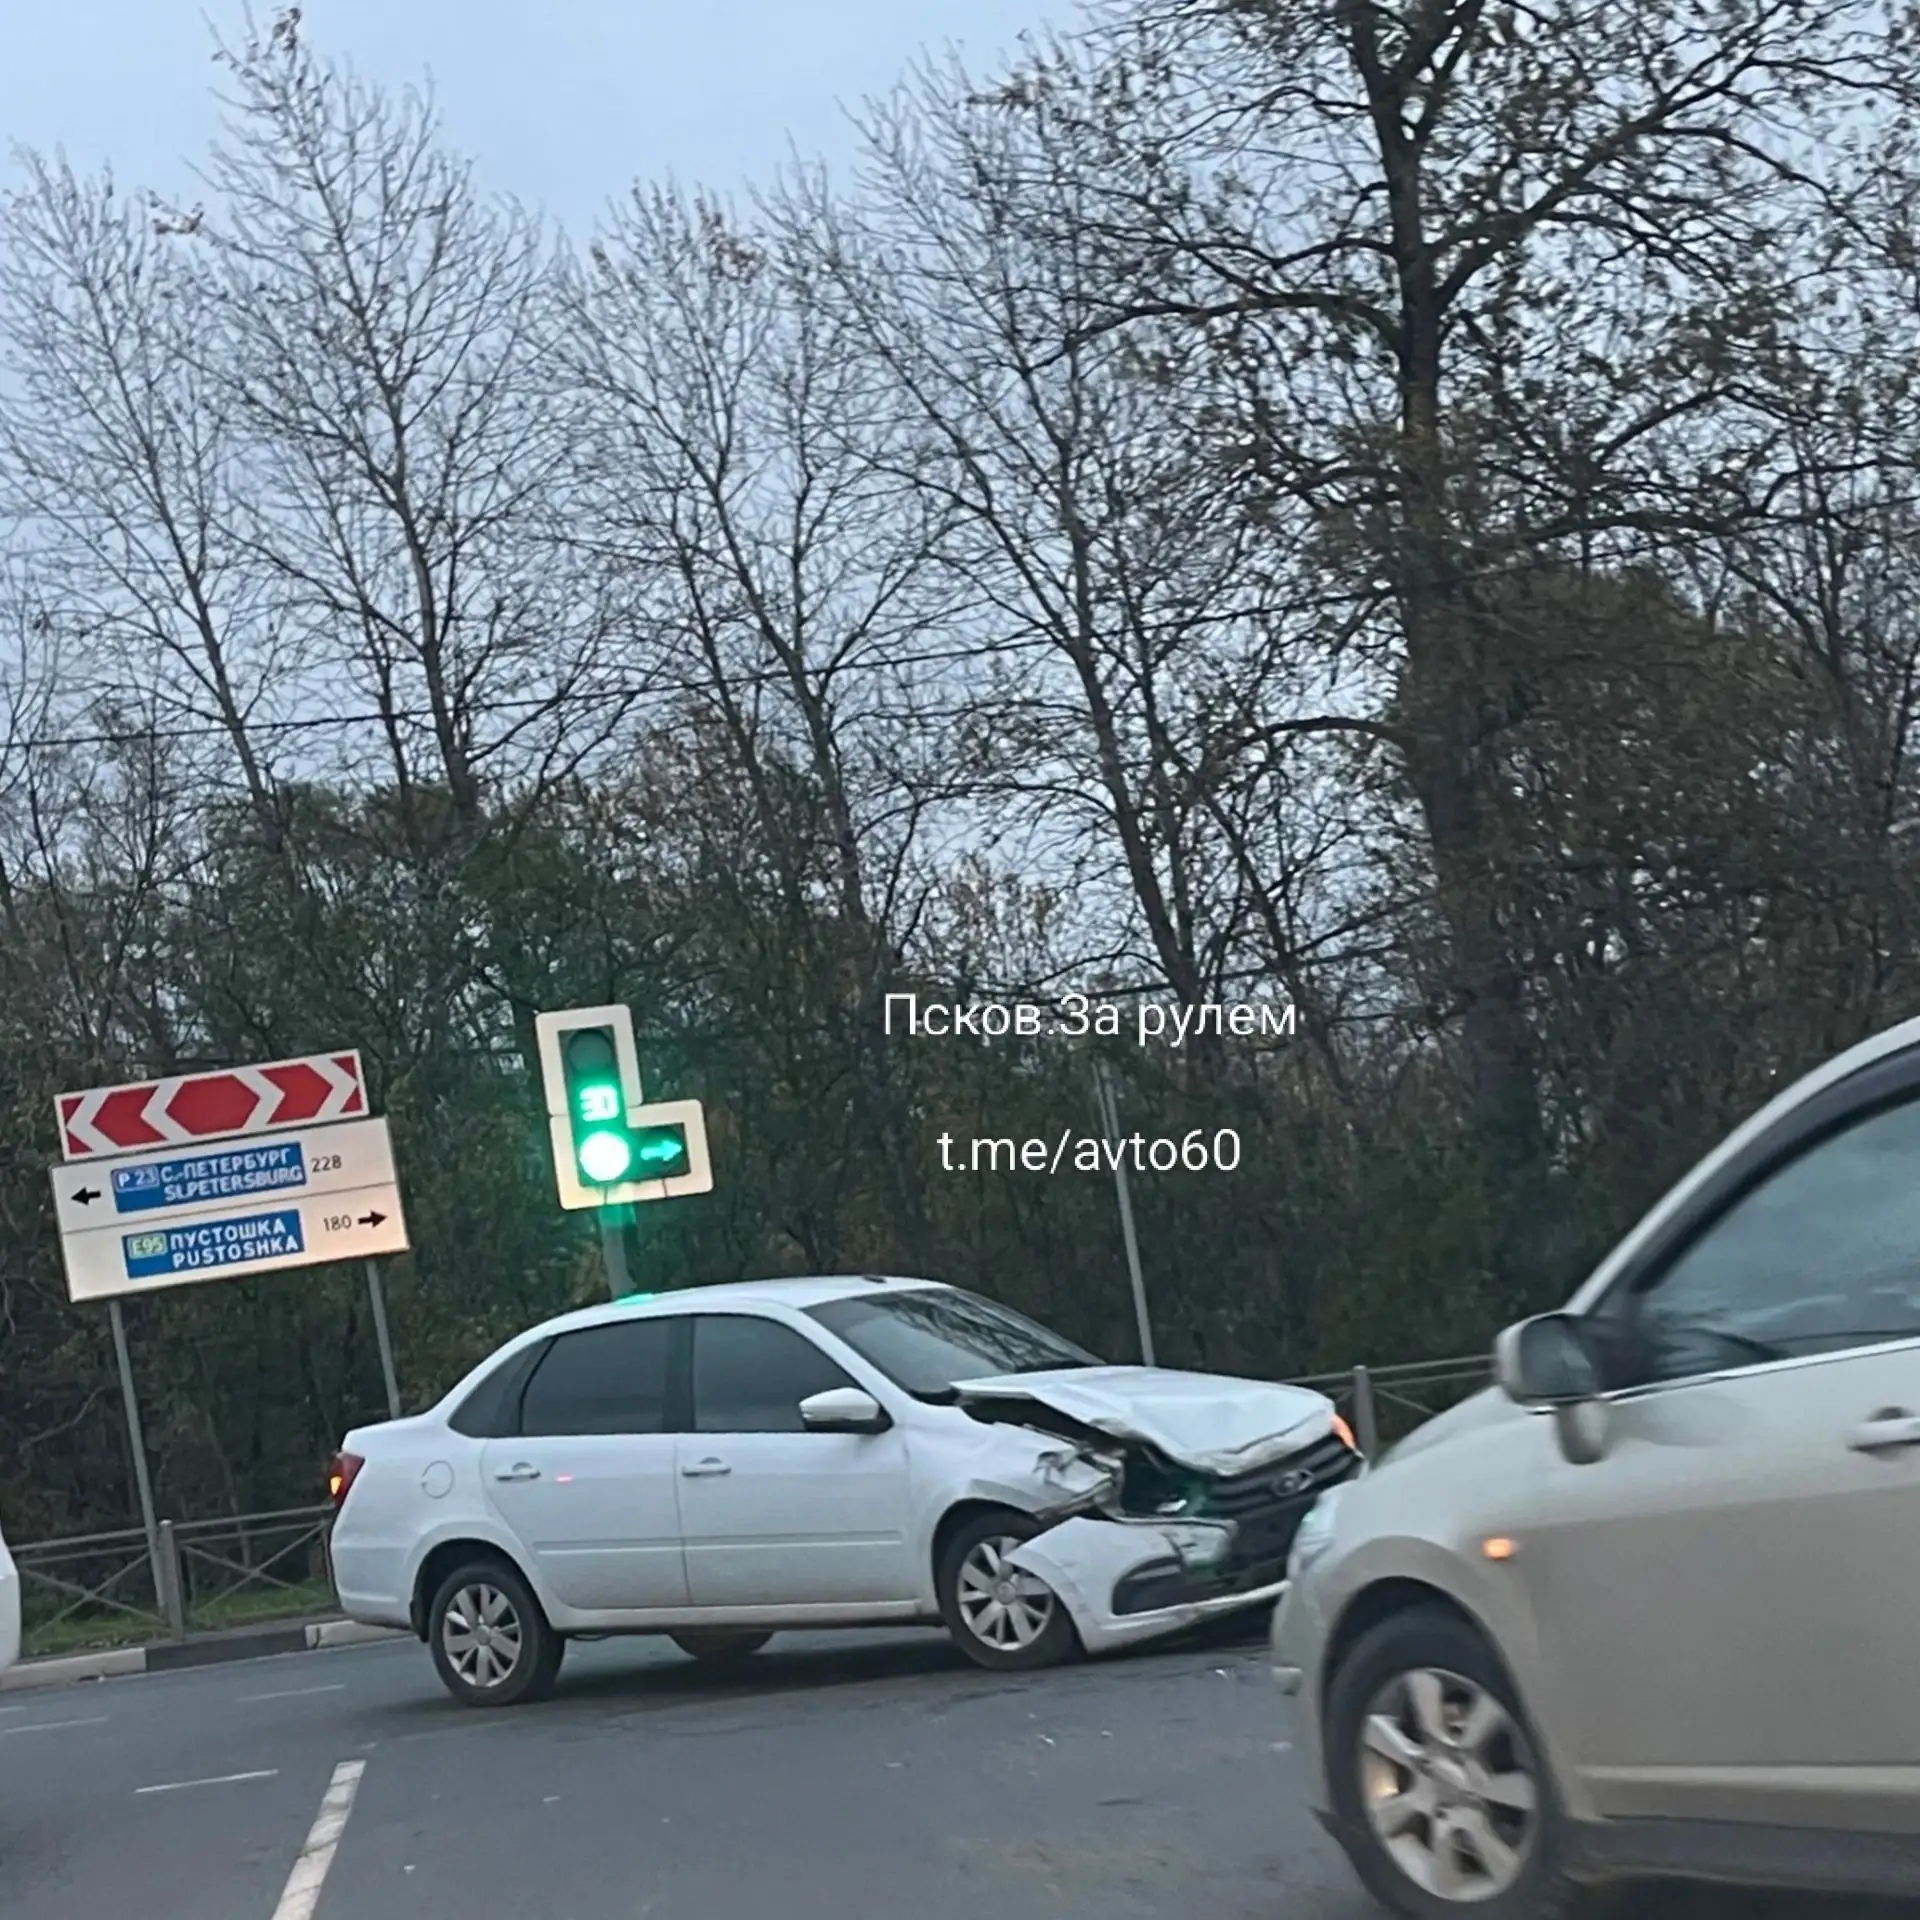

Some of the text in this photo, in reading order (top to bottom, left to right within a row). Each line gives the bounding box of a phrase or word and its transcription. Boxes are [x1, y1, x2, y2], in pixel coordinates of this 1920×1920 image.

[311, 1154, 342, 1173] 228
[323, 1214, 352, 1232] 180
[170, 1218, 286, 1250] ПУСТОШКА
[132, 1237, 163, 1256] E95
[172, 1234, 299, 1268] PUSTOSHKA
